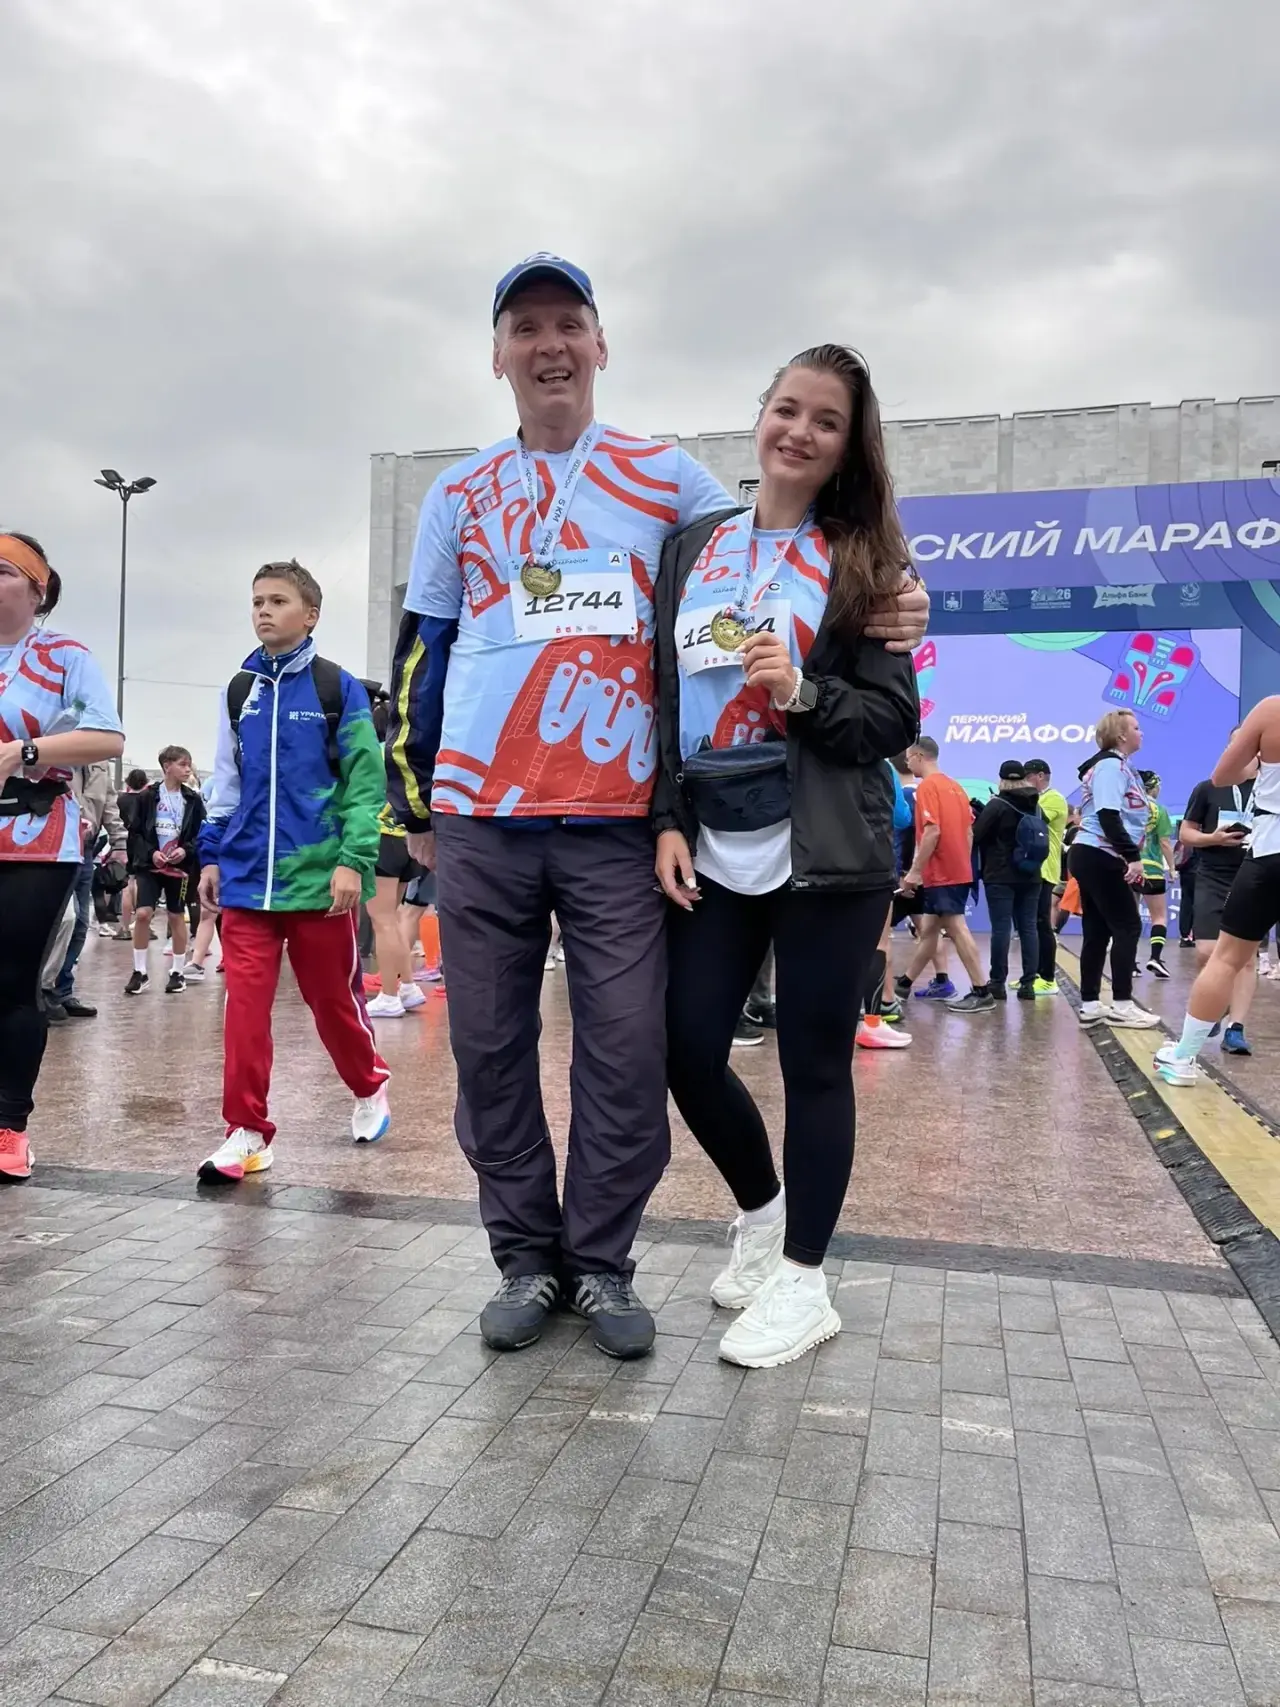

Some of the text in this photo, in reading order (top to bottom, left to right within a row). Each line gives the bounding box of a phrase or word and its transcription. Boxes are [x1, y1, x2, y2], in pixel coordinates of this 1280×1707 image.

[552, 506, 564, 522] KM
[1073, 518, 1280, 555] МАРАФ
[524, 591, 623, 616] 12744
[682, 616, 776, 650] 124
[950, 712, 1028, 725] ПЕРМСКИЙ
